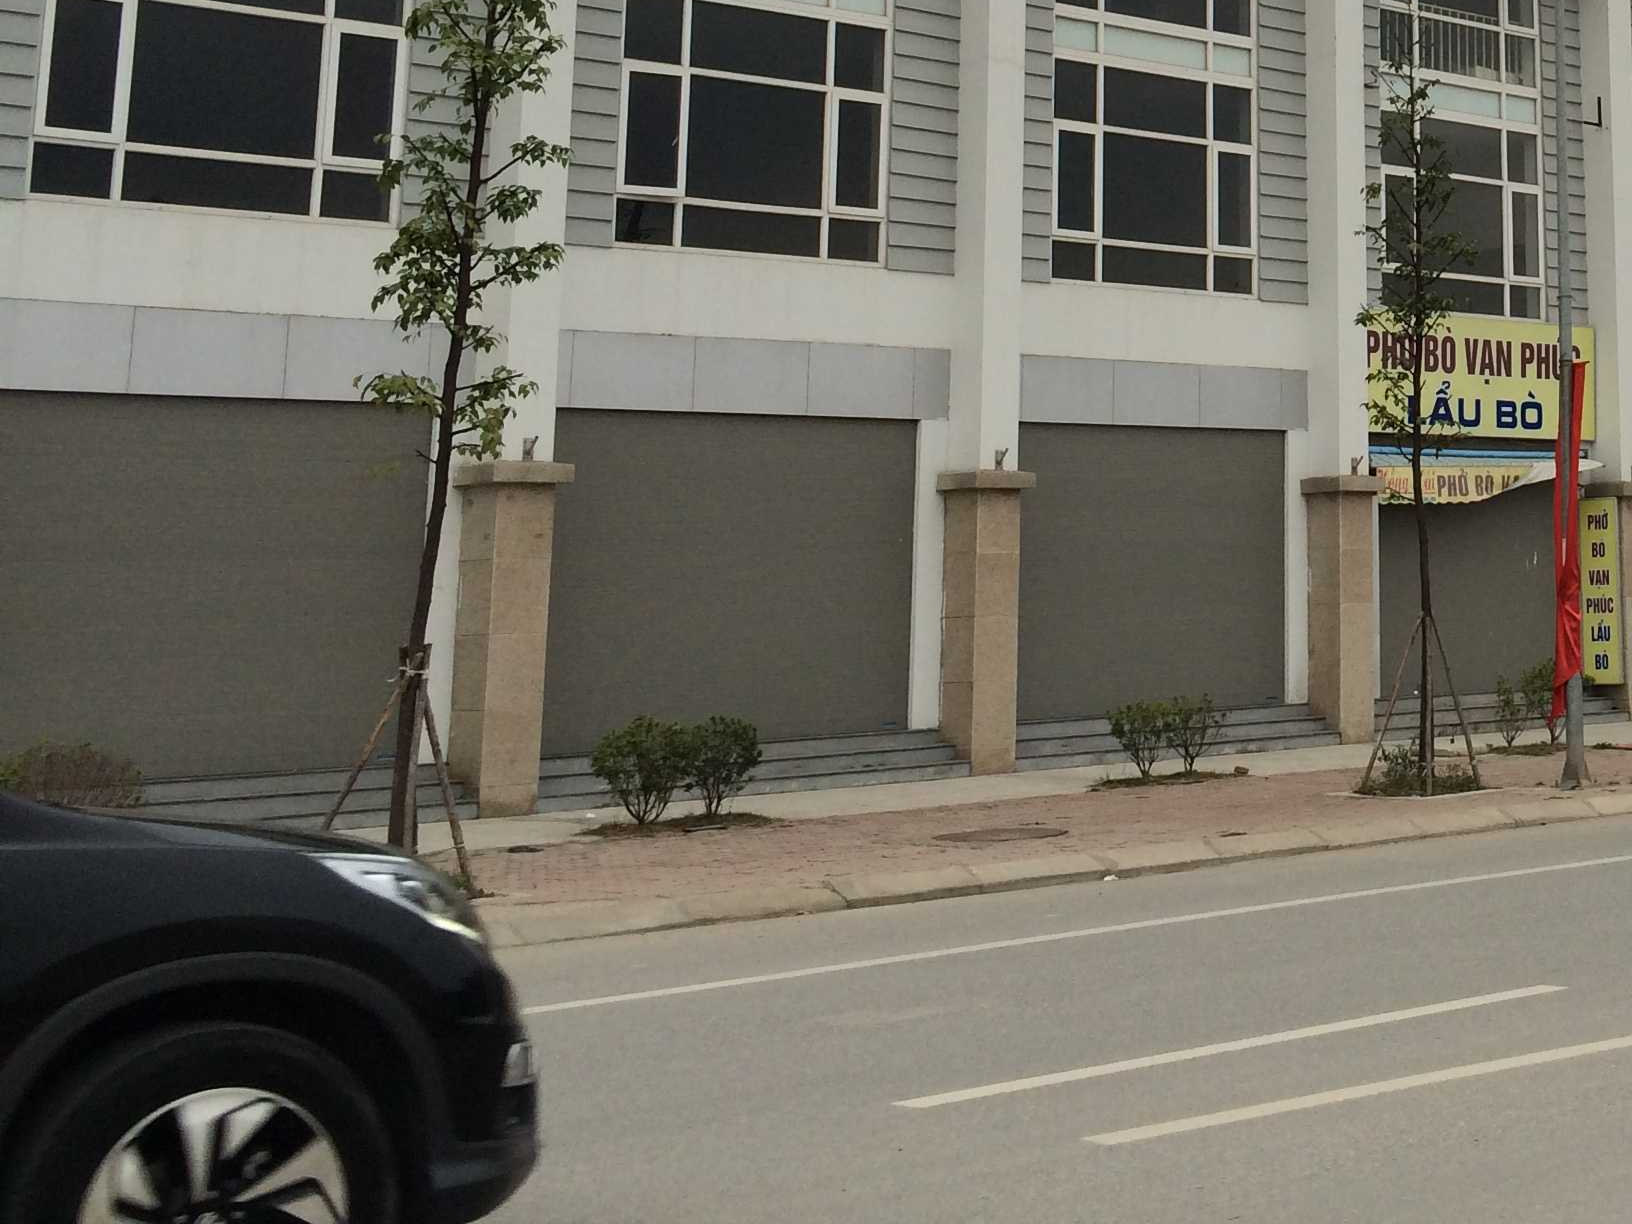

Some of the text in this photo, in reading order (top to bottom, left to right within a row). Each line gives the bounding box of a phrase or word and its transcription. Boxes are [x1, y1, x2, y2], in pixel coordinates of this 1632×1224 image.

[1424, 326, 1456, 374] BÒ
[1464, 338, 1513, 385] VẠN
[1520, 336, 1581, 381] PHÚ
[1408, 380, 1543, 430] LẨU BÒ
[1587, 509, 1609, 530] PHỞ
[1588, 569, 1610, 589] VẠN
[1586, 593, 1614, 614] PHÚC
